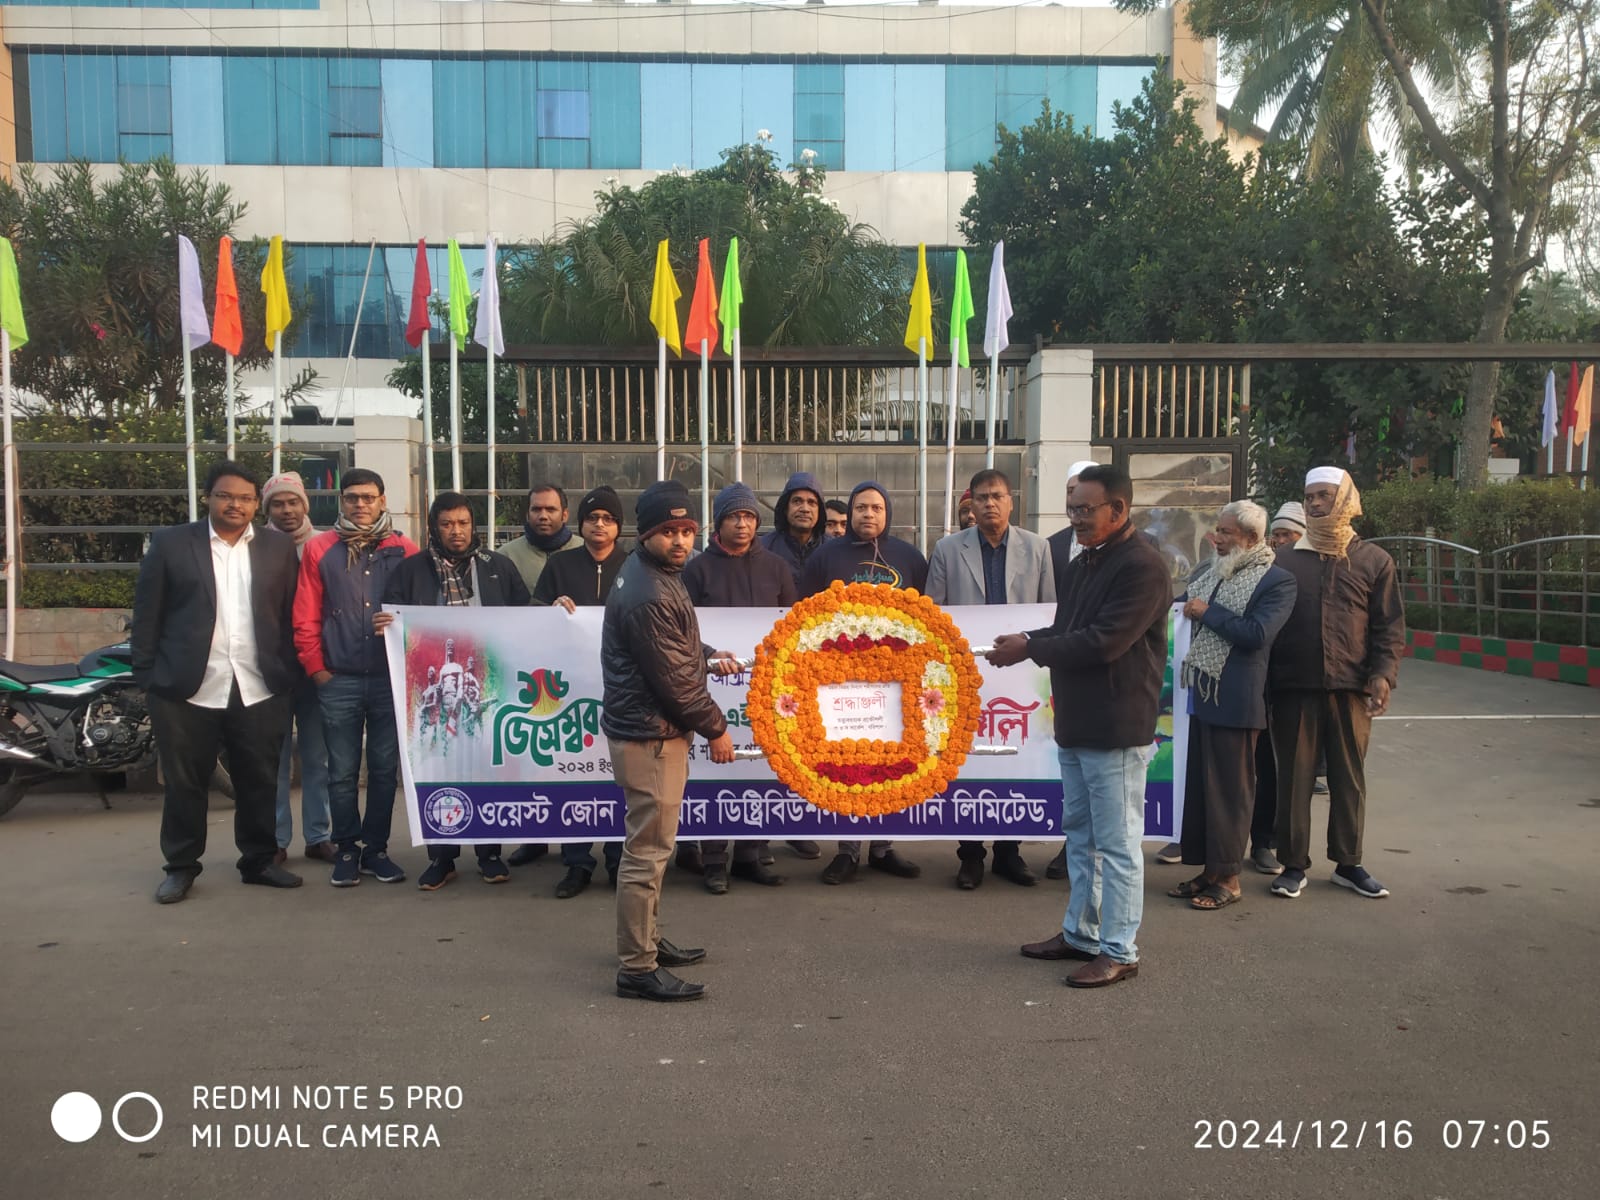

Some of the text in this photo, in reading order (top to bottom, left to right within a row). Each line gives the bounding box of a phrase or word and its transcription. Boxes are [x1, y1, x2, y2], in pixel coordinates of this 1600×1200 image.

[492, 698, 603, 767] ডিসেম্বর
[558, 761, 594, 774] ২০২৪
[477, 792, 552, 827] ওয়েস্ট
[561, 797, 617, 827] জোন
[951, 789, 1054, 831] লিমিটেড,
